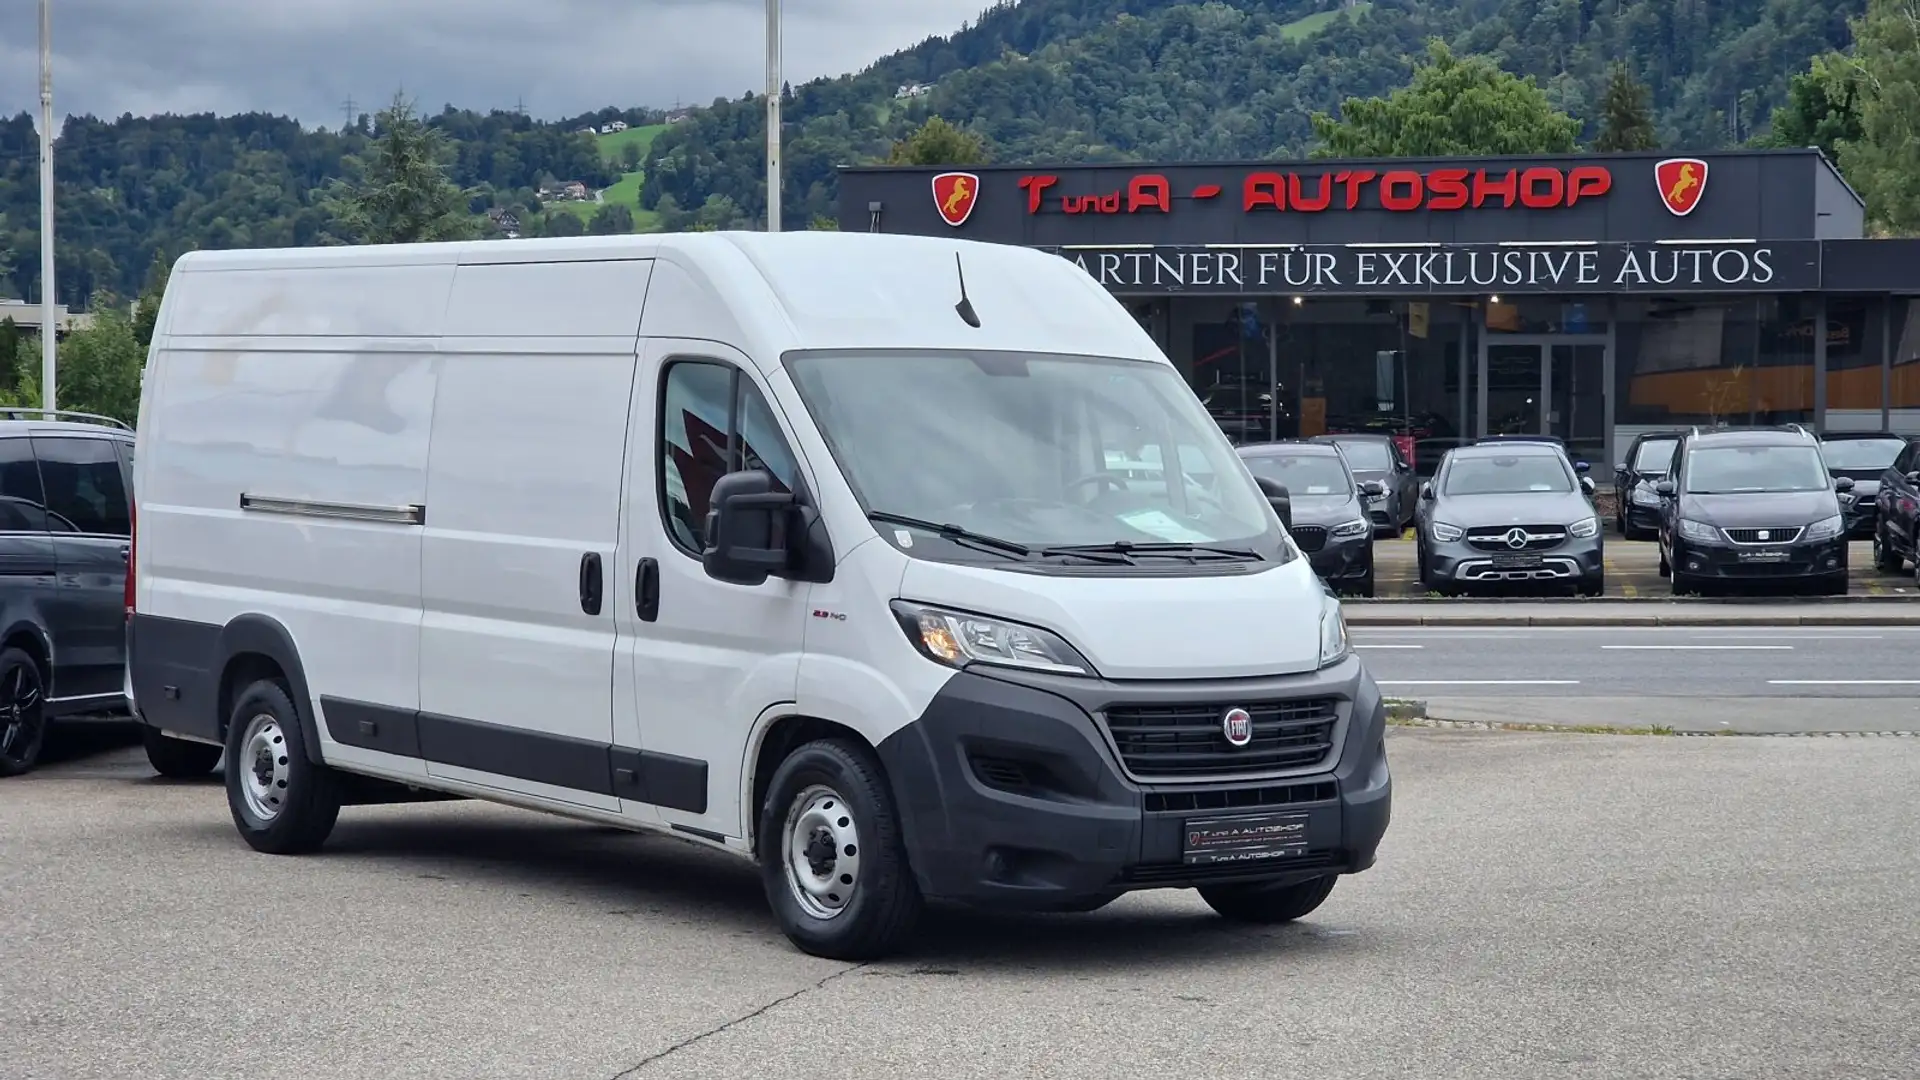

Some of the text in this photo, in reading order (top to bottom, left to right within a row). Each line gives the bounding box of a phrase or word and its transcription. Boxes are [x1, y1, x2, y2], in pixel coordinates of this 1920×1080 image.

[1242, 165, 1613, 213] AUTOSHOP
[1074, 247, 1775, 286] ARTNER FÜR EXKLUSIVE AUTOS
[1231, 719, 1247, 736] FIAT
